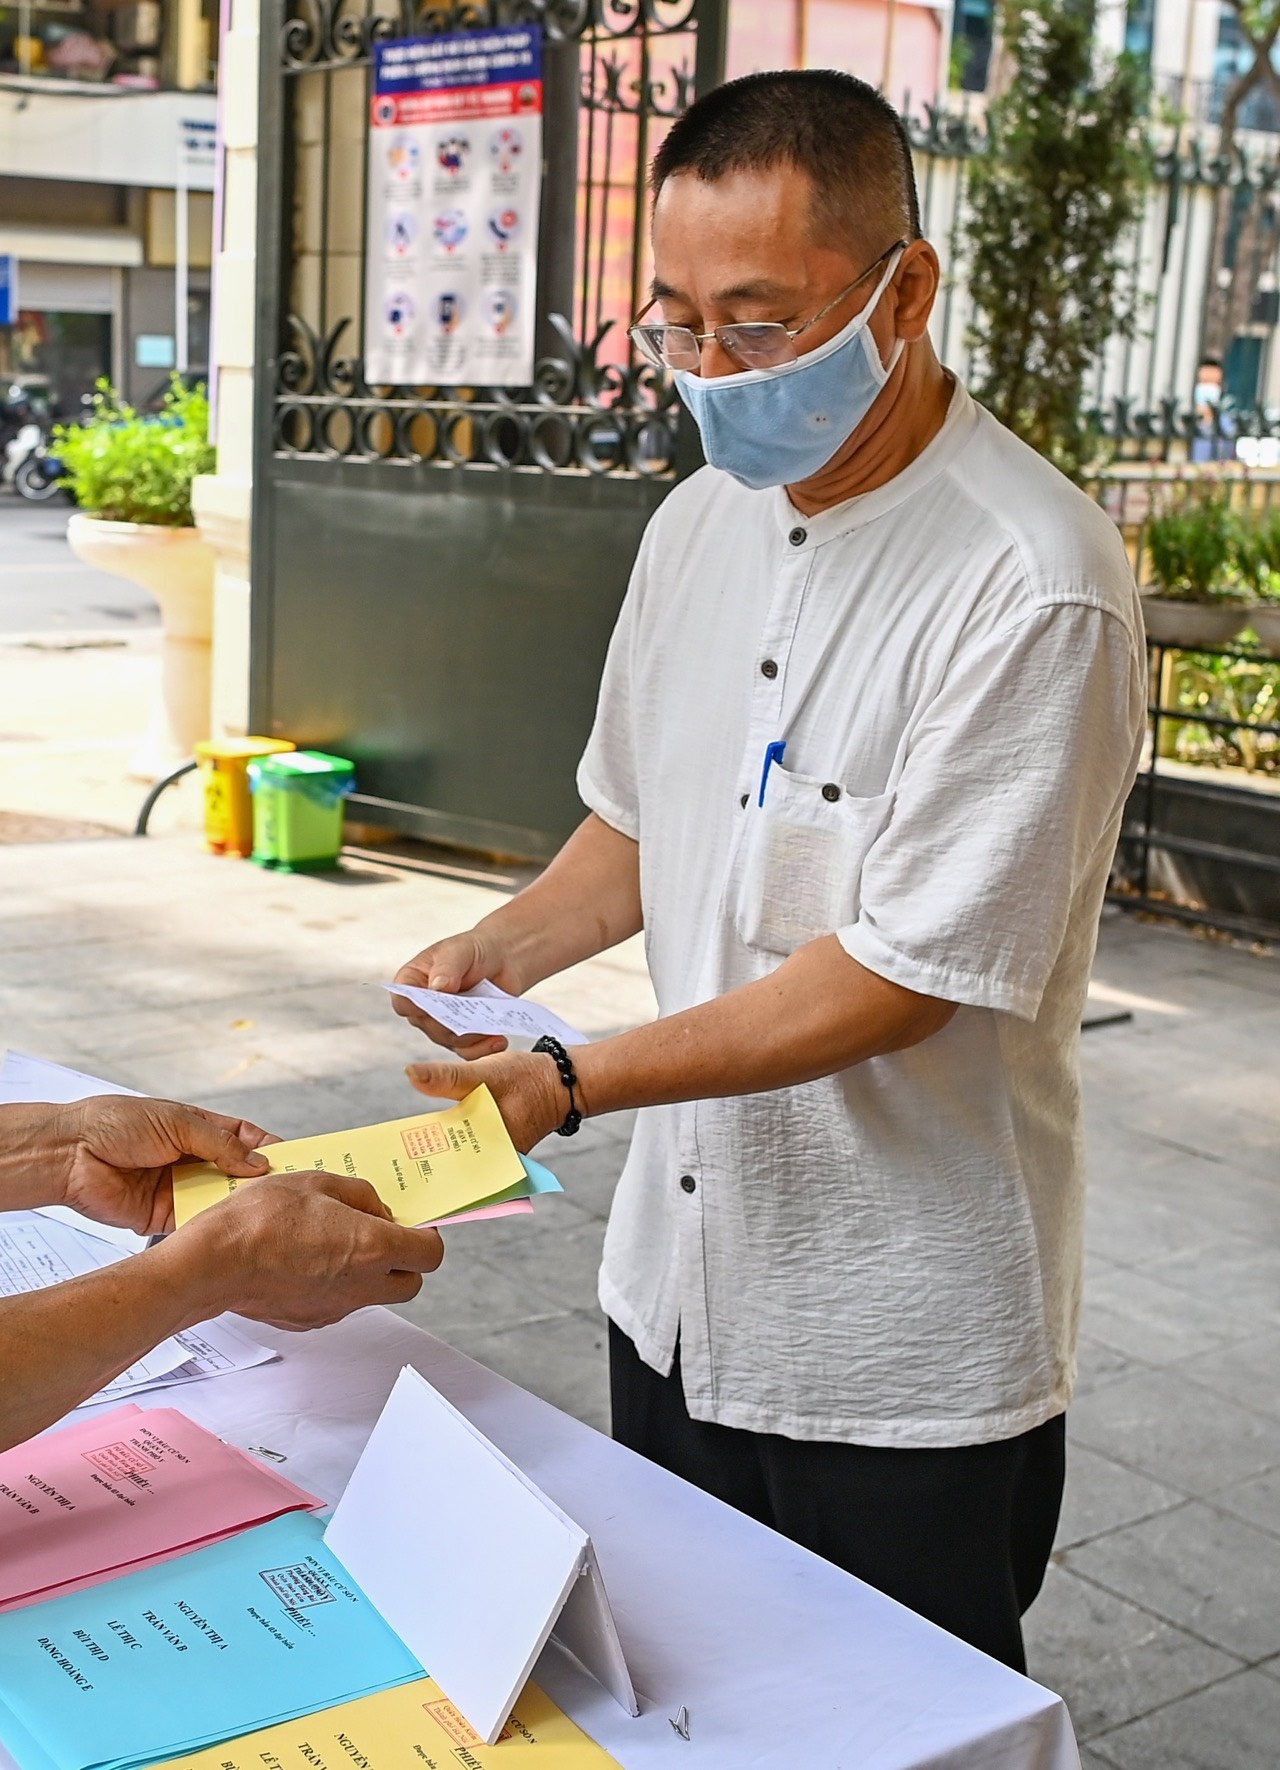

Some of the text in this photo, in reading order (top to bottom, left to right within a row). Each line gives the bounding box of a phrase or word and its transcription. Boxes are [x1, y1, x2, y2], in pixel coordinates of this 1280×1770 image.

[124, 1469, 152, 1488] PHIẾU
[25, 1474, 59, 1496] NGUYỄN
[54, 1495, 71, 1506] THỊ
[16, 1498, 34, 1510] VĂN
[174, 1601, 210, 1630] NGUYỄN
[205, 1629, 223, 1644] THỊ
[284, 1607, 314, 1627] PHIẾU
[72, 1630, 91, 1642] BÙI
[85, 1642, 104, 1656] THỊ
[107, 1621, 125, 1631] LÊ
[117, 1630, 136, 1644] THỊ
[162, 1630, 183, 1645] VĂN
[37, 1638, 63, 1659] ĐẶNG
[56, 1658, 88, 1685] HOÀNG
[259, 1752, 279, 1764] LÊ
